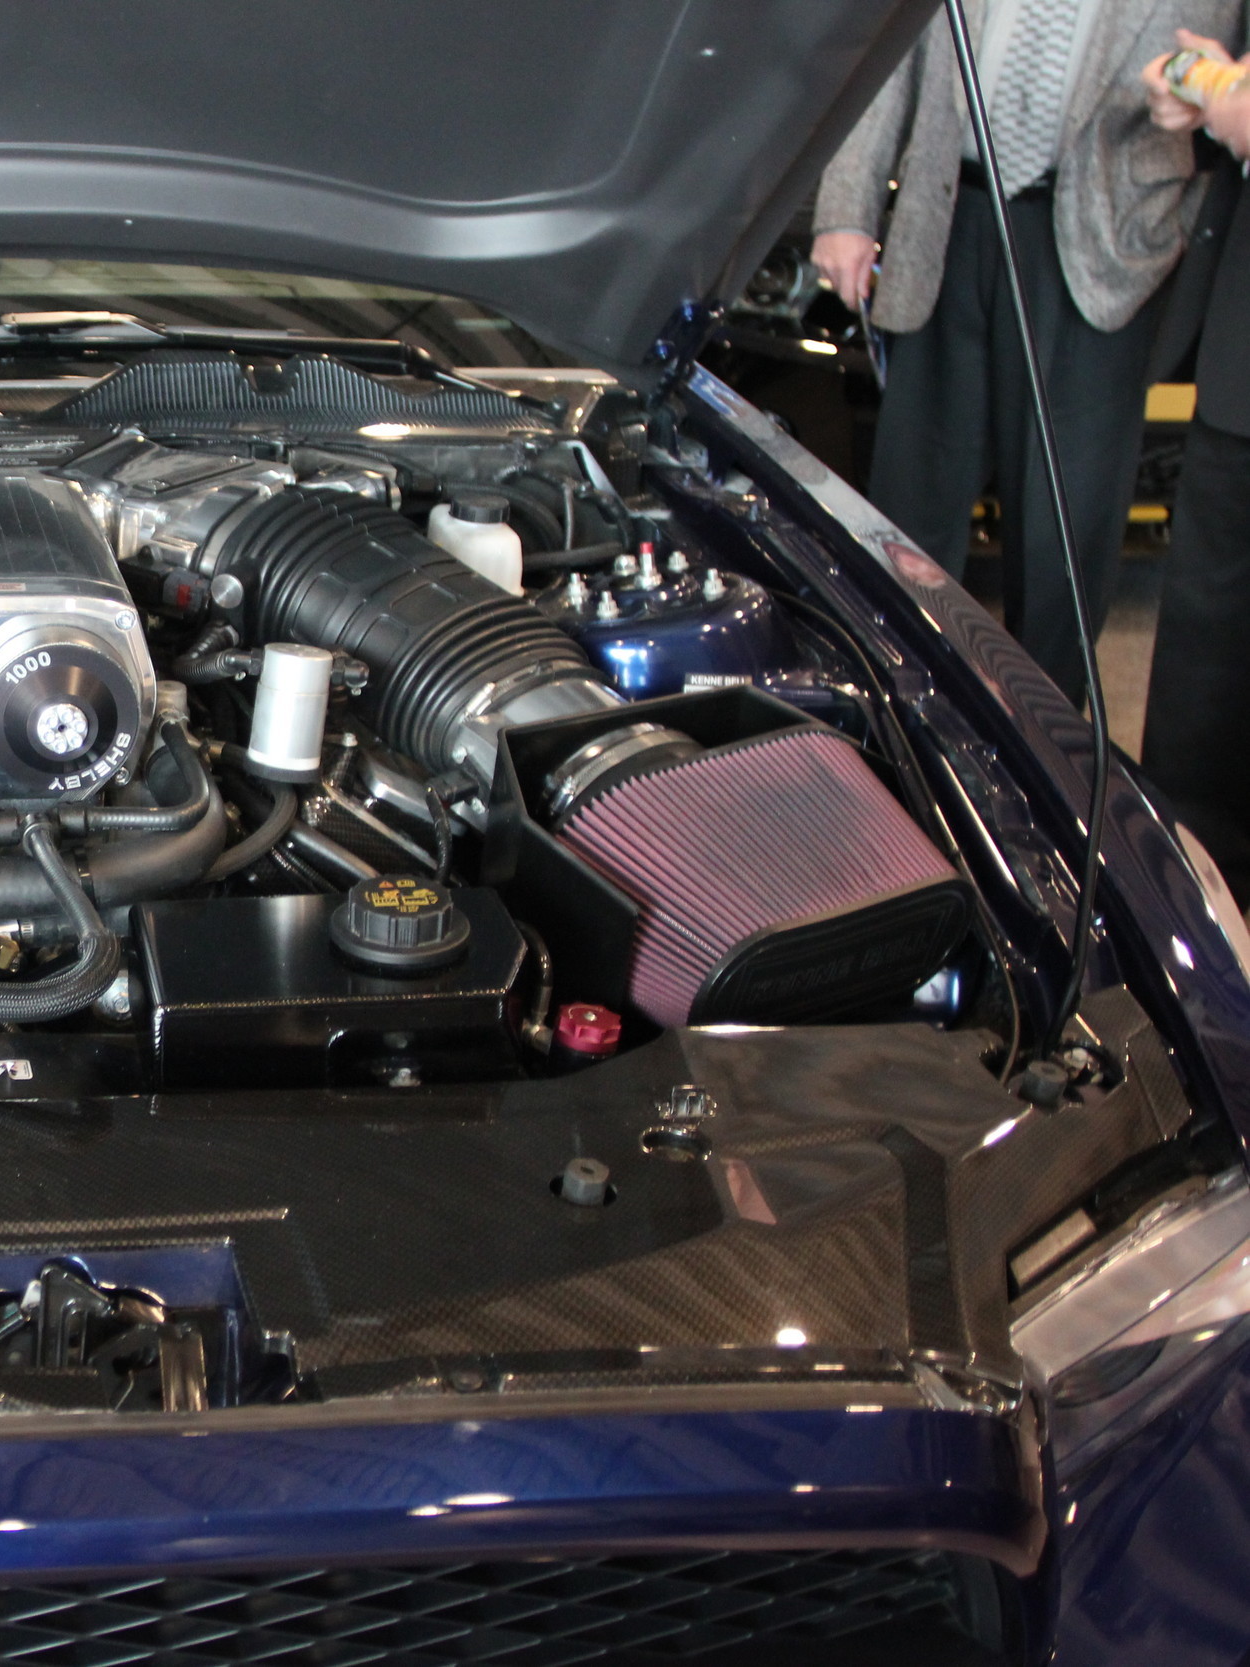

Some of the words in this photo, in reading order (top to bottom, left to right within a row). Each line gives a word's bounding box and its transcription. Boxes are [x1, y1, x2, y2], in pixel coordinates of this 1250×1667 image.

[5, 651, 52, 685] 1000
[690, 674, 723, 686] KENNE
[48, 732, 132, 791] SHELBY
